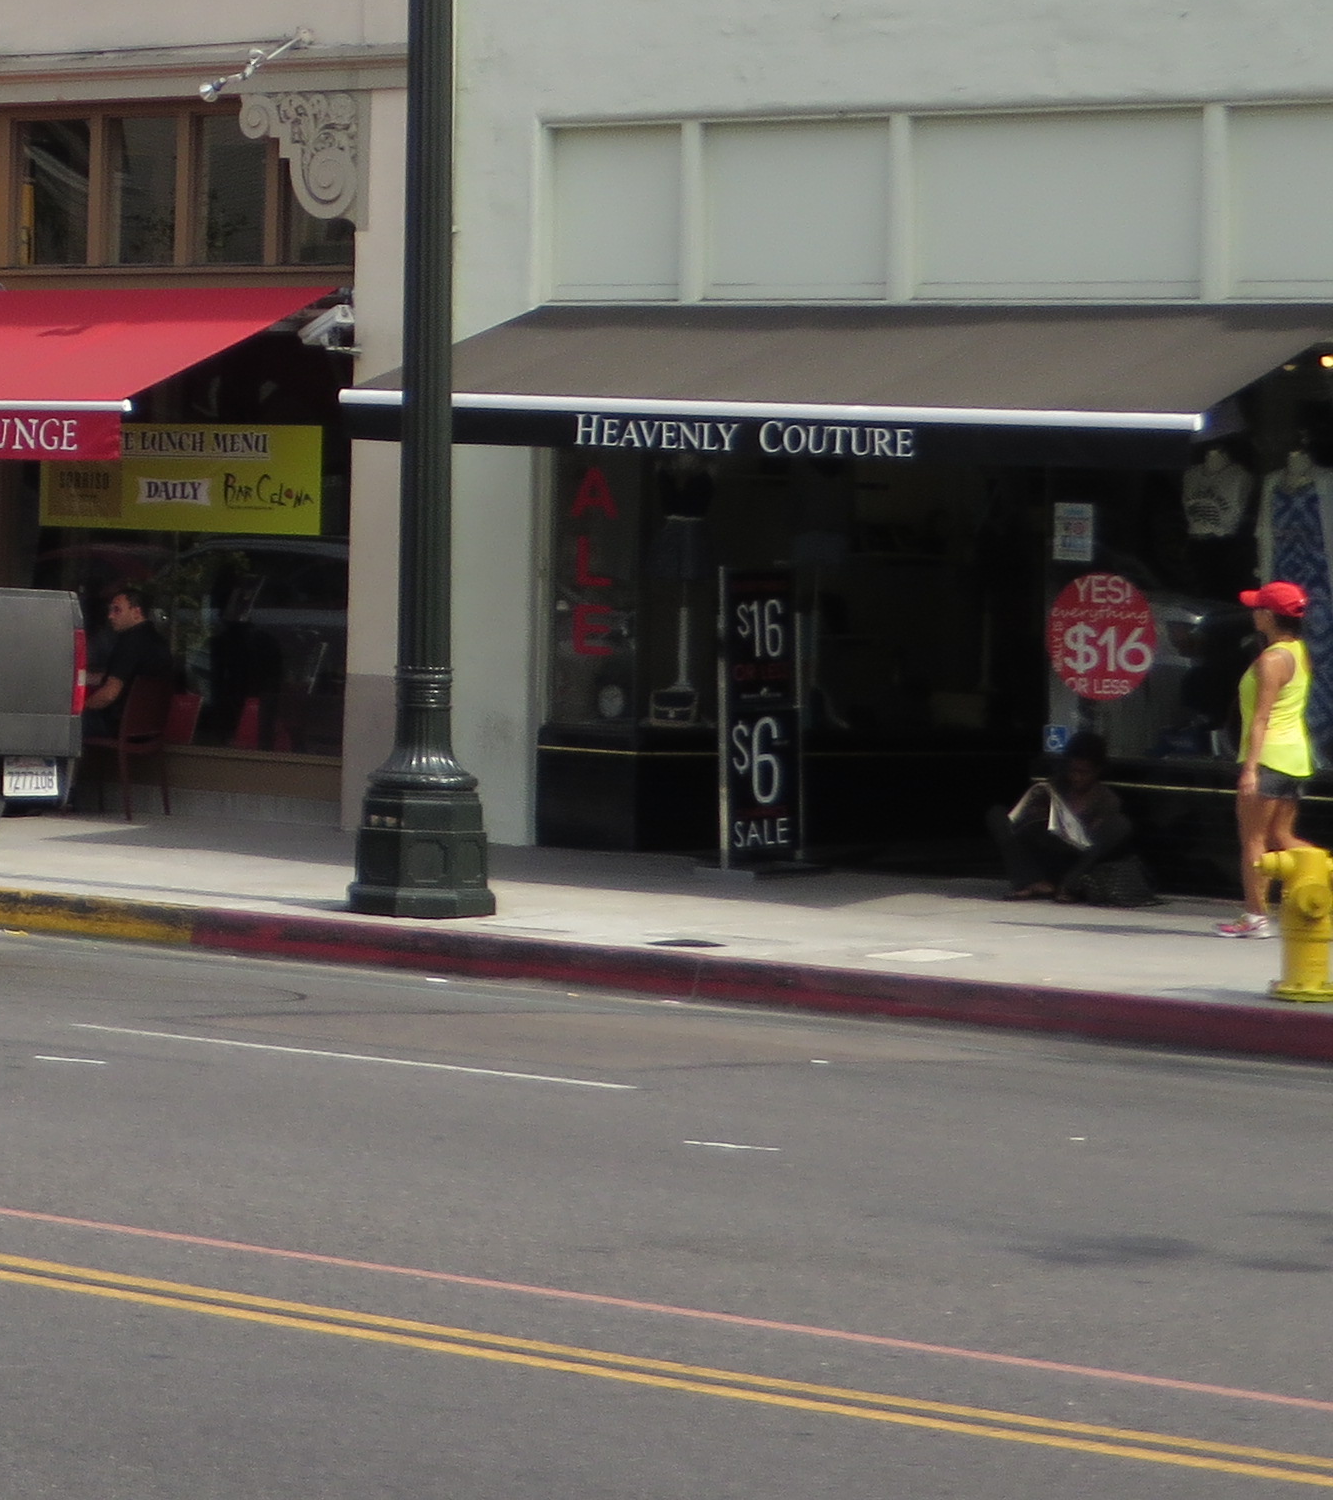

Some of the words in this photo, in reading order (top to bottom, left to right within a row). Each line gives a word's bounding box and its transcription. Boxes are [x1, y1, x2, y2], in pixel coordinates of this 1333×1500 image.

[140, 431, 205, 452] LUNCH
[213, 432, 269, 453] MENU
[146, 479, 202, 501] DAILY
[570, 466, 619, 657] ALE
[1074, 575, 1133, 605] YES!
[735, 598, 783, 658] $16
[1051, 606, 1151, 625] everything
[1063, 621, 1153, 674] $16
[1065, 677, 1089, 694] OR
[1093, 678, 1132, 696] LESS
[732, 716, 780, 804] $6
[734, 817, 789, 848] SALE
